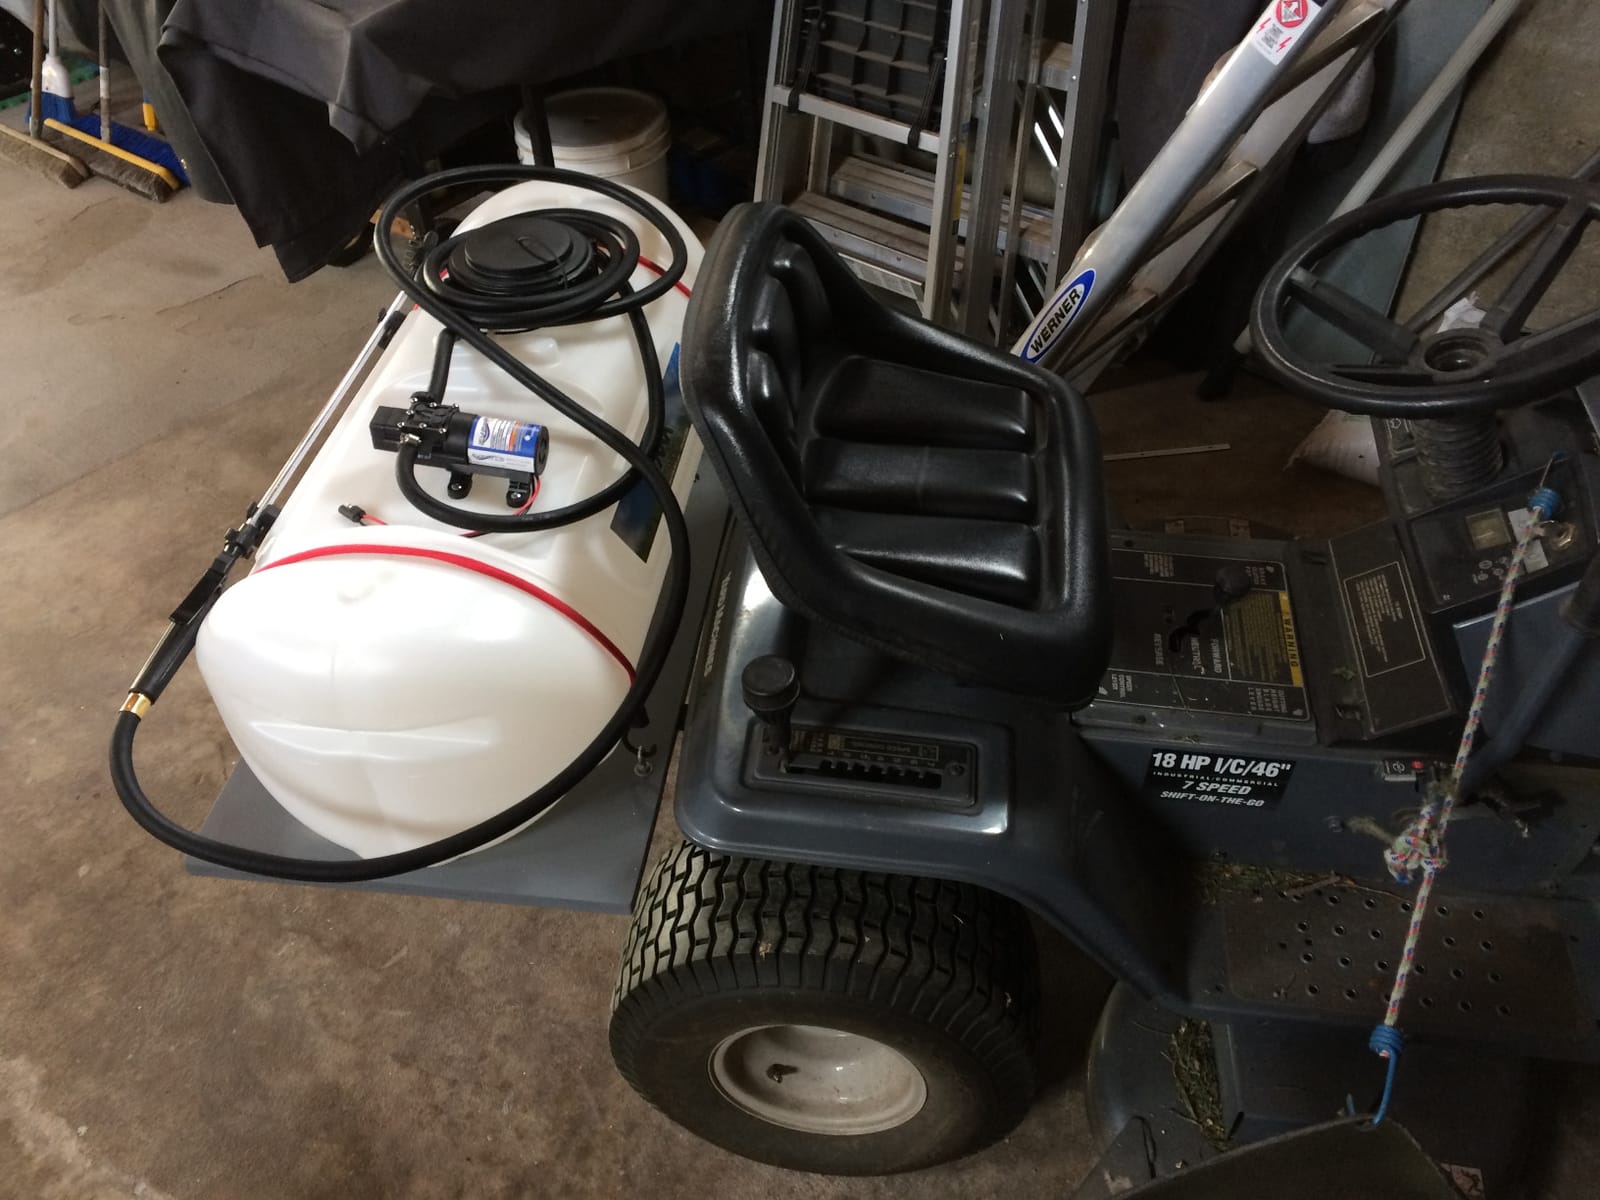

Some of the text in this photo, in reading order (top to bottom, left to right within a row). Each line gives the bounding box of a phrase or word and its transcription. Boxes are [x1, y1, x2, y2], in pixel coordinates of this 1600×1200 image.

[1031, 289, 1080, 353] WERNER
[1284, 619, 1299, 668] WARNING
[1152, 752, 1292, 778] 18 HP I/C/46"
[1153, 771, 1279, 787] INDUSTRIAL/COMMERCIAL
[1181, 780, 1252, 795] 7 SPEED
[1160, 790, 1265, 807] SHIFT-ON-THE-GO
